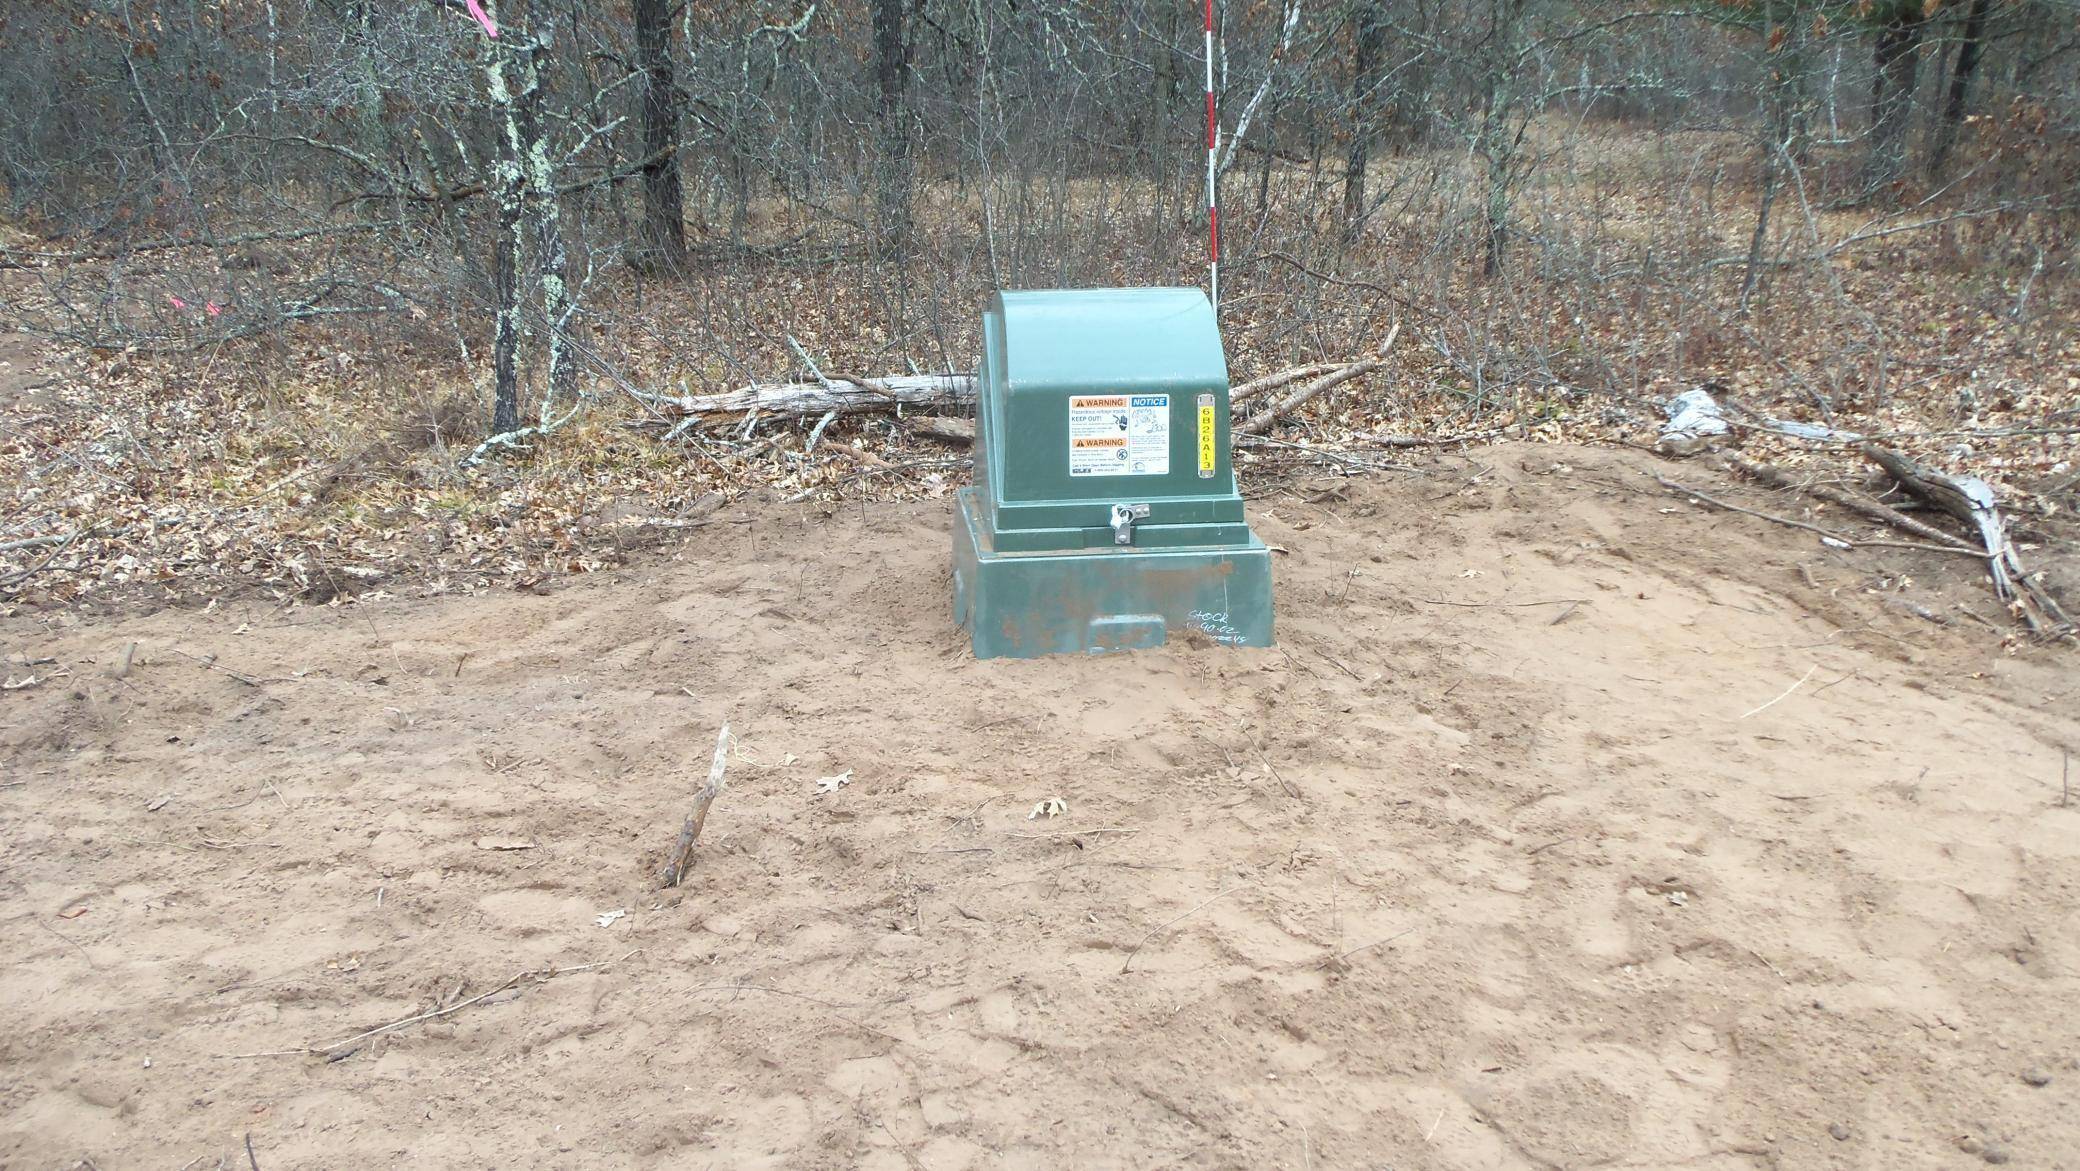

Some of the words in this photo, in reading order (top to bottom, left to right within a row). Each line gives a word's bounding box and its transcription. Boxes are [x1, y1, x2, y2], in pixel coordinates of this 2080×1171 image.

[1086, 399, 1123, 407] WARNING
[1133, 398, 1166, 406] NOTICE
[1086, 439, 1123, 447] WARNING
